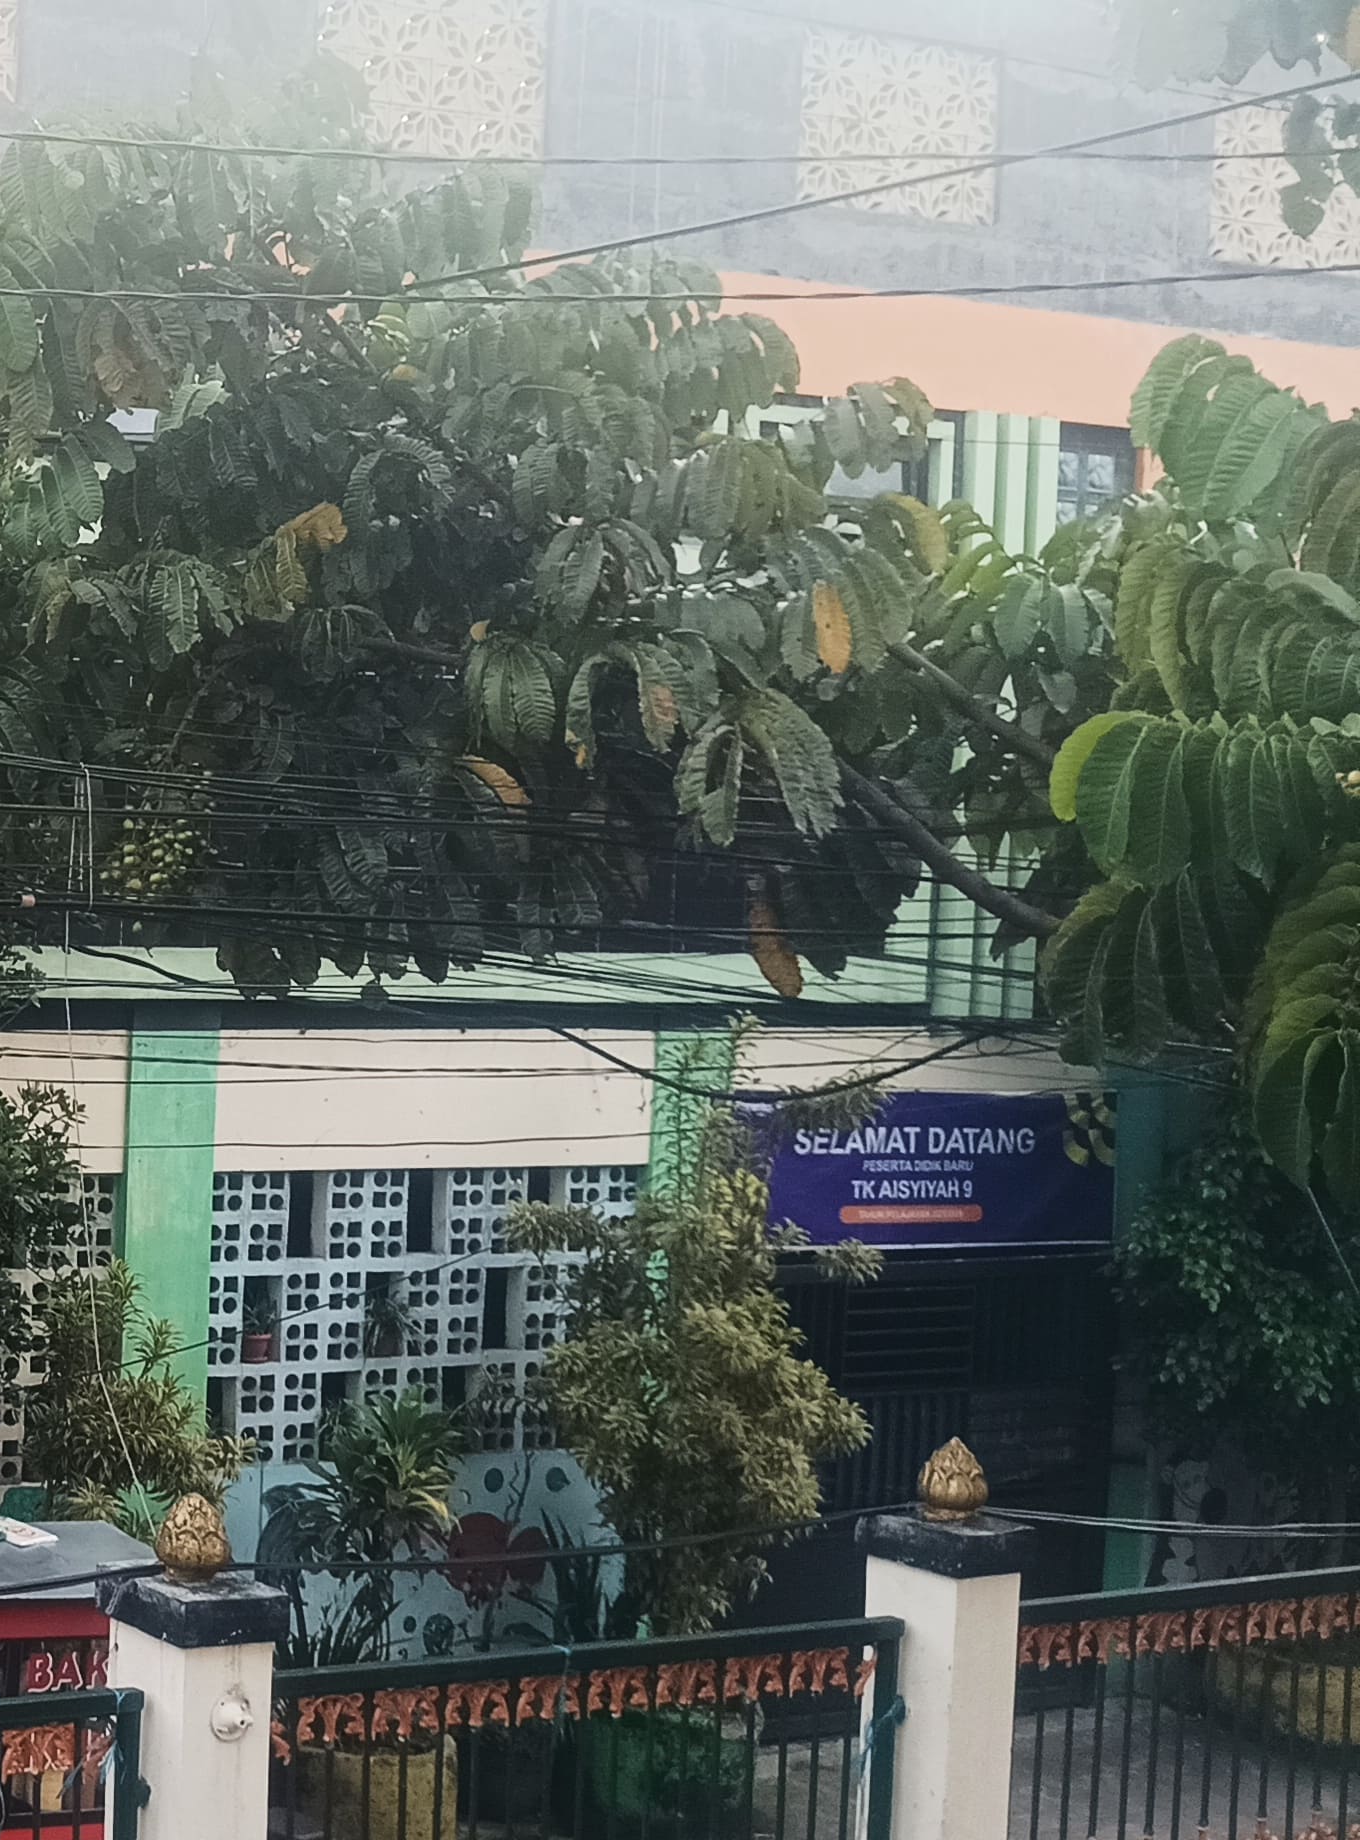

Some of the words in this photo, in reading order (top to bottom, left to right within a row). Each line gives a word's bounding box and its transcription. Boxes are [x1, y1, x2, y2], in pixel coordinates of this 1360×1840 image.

[793, 1127, 920, 1155] SELAMAT
[928, 1127, 1035, 1154] DATANG
[862, 1159, 913, 1171] PESERTA
[943, 1160, 974, 1171] BARU
[851, 1180, 875, 1198] TK
[879, 1180, 959, 1198] AISYIYAH
[963, 1180, 972, 1198] 9
